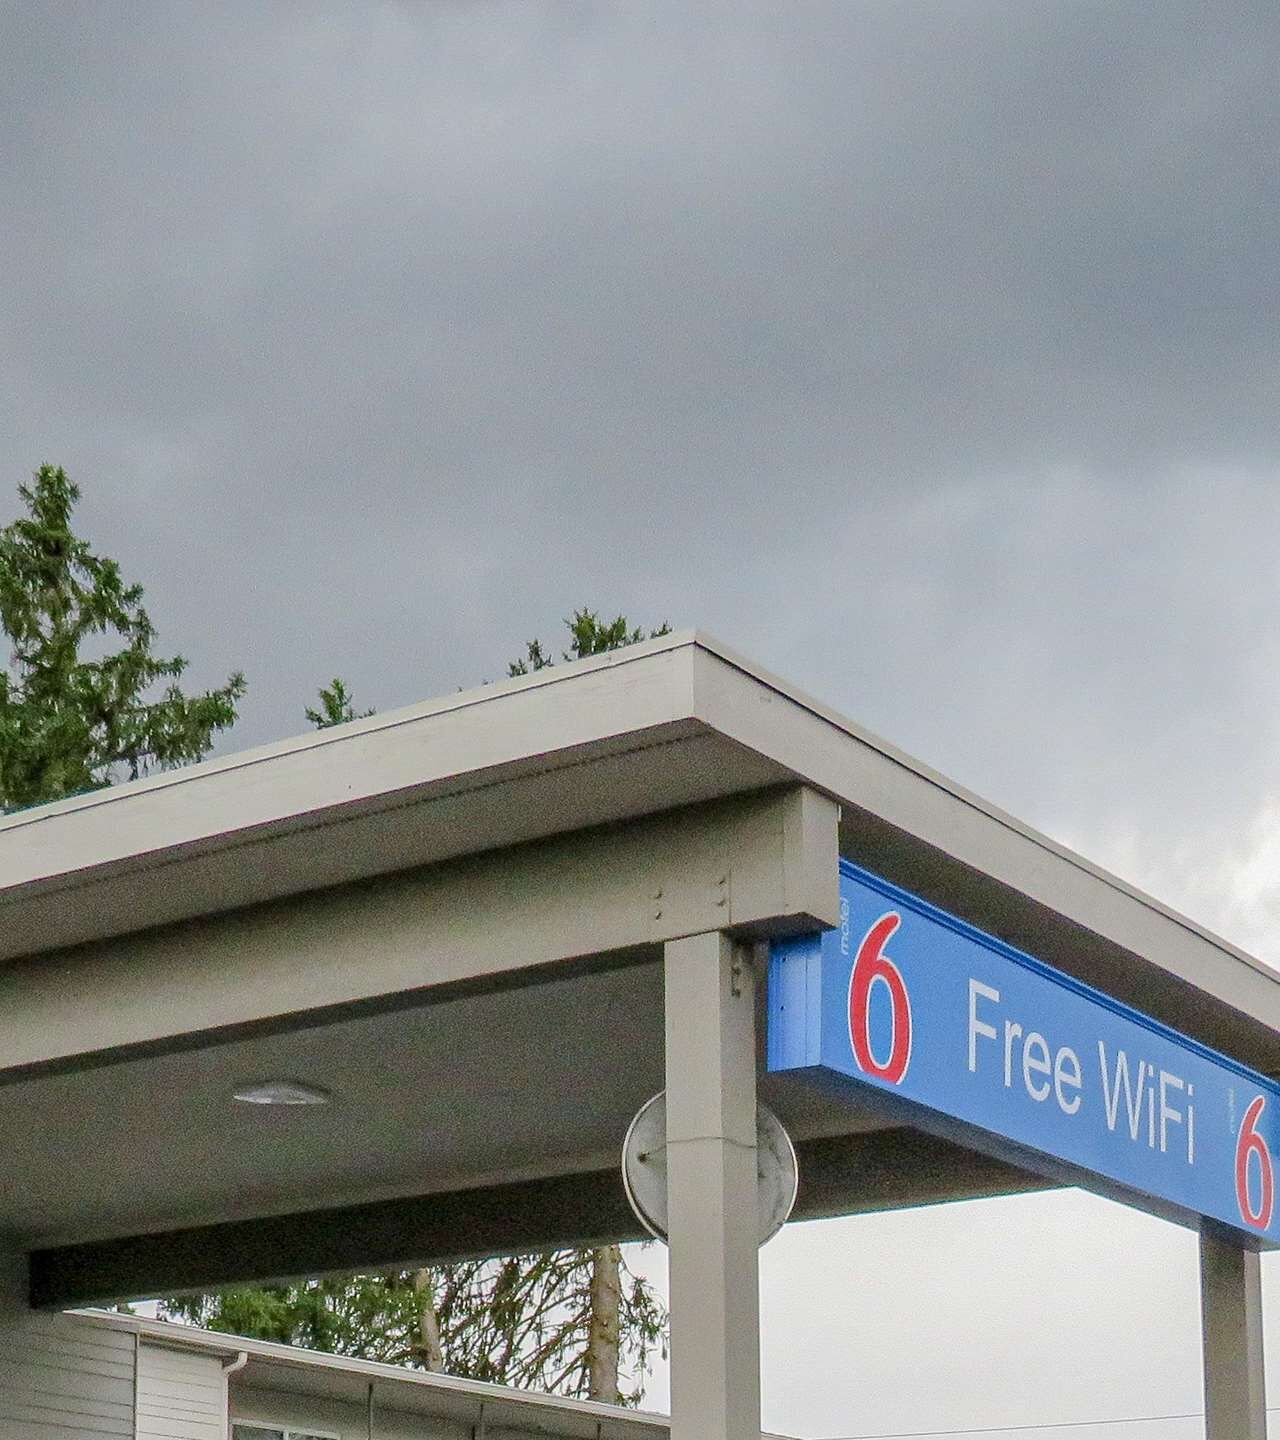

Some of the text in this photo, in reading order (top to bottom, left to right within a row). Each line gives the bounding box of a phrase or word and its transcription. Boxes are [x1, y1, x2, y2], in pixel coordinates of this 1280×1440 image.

[848, 910, 912, 1086] 6
[968, 978, 1194, 1165] Free WiFi
[1235, 1095, 1274, 1232] 6
